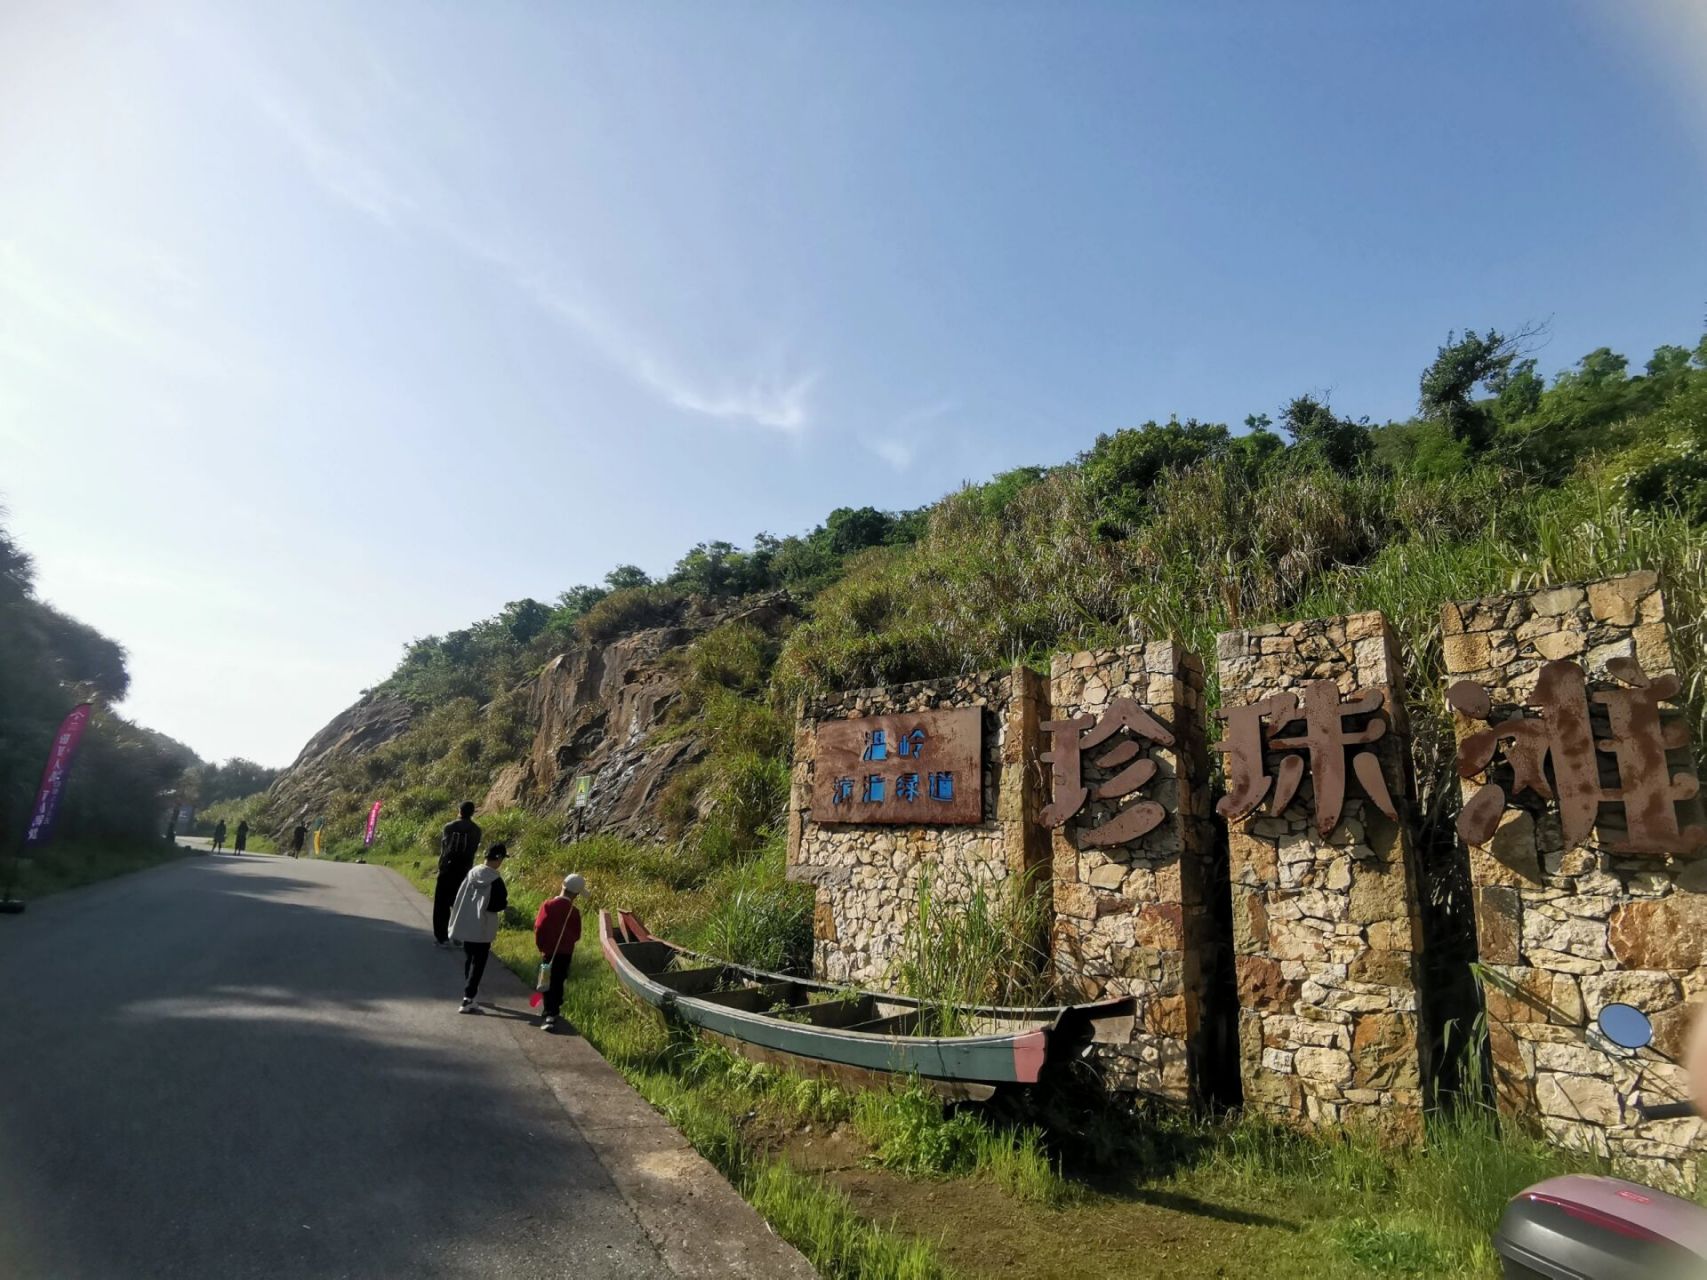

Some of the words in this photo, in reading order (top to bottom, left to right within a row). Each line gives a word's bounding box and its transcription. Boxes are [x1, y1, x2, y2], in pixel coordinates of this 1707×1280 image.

[863, 728, 925, 761] 温岭
[1039, 656, 1707, 856] 珍珠滩
